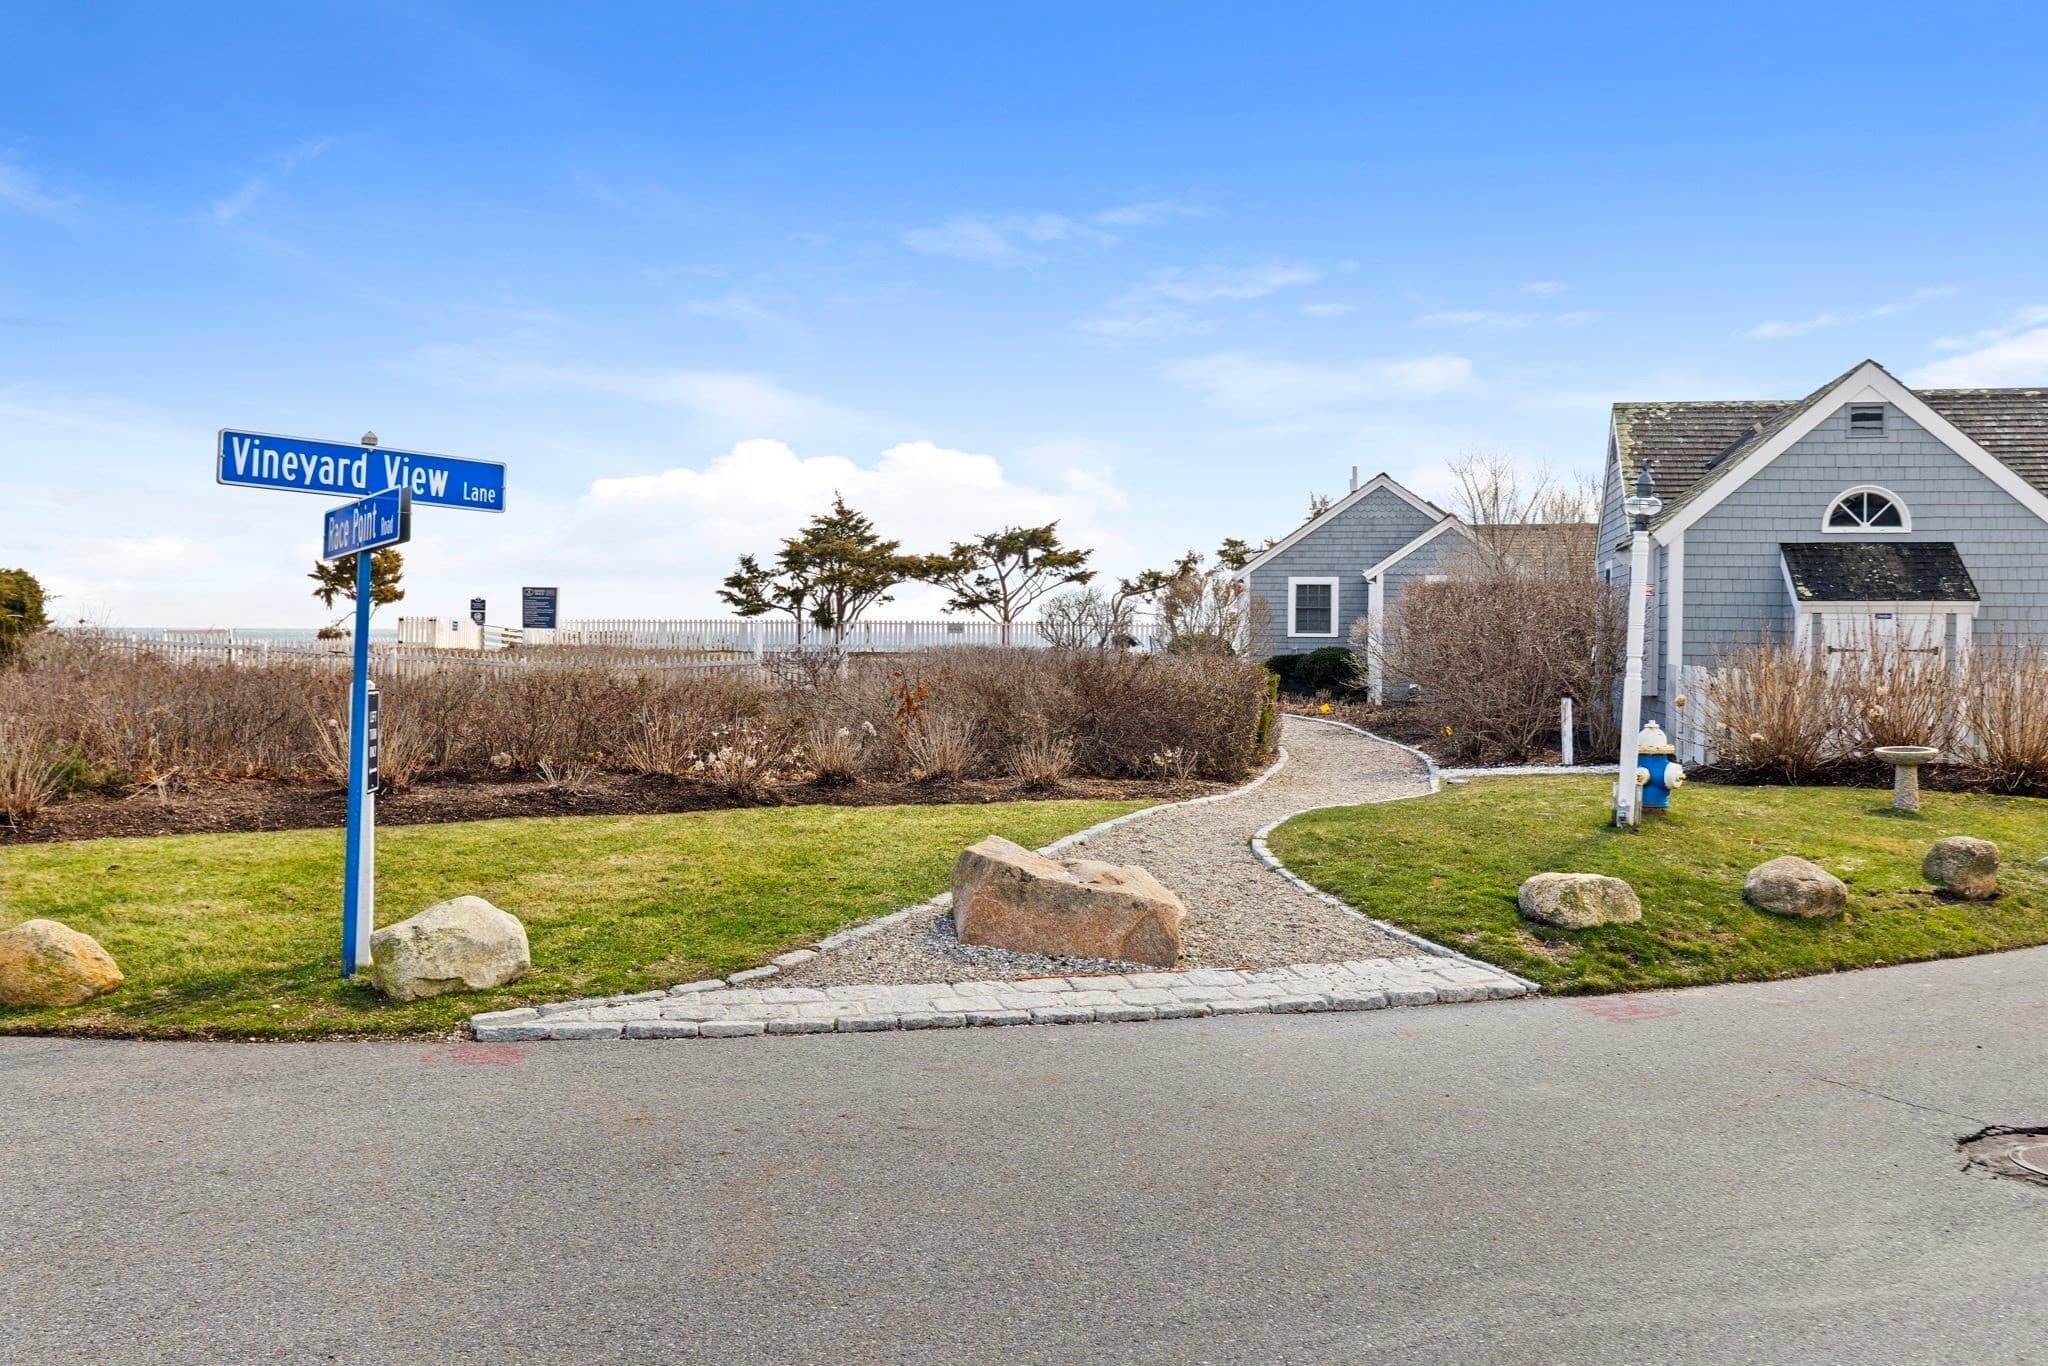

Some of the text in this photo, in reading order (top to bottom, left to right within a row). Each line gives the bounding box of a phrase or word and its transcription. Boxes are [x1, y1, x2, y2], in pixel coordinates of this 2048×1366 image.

[232, 436, 496, 503] Vineyard View Lane
[328, 501, 394, 552] Race Point Road
